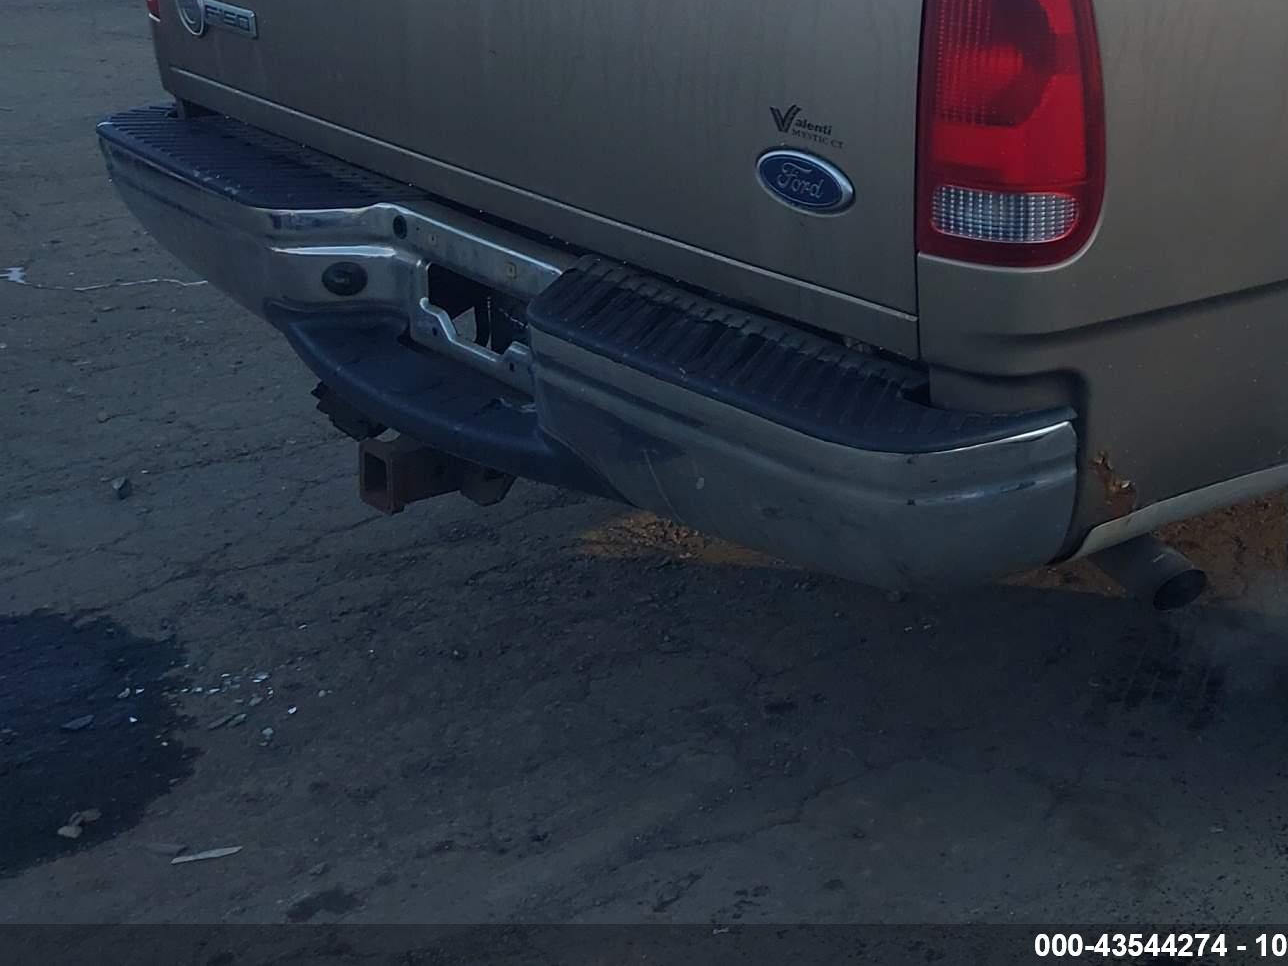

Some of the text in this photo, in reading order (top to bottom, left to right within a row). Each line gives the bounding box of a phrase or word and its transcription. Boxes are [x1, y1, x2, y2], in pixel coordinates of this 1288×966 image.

[769, 104, 833, 136] Valenti
[792, 129, 828, 146] MYSTIC
[776, 161, 827, 200] Ford
